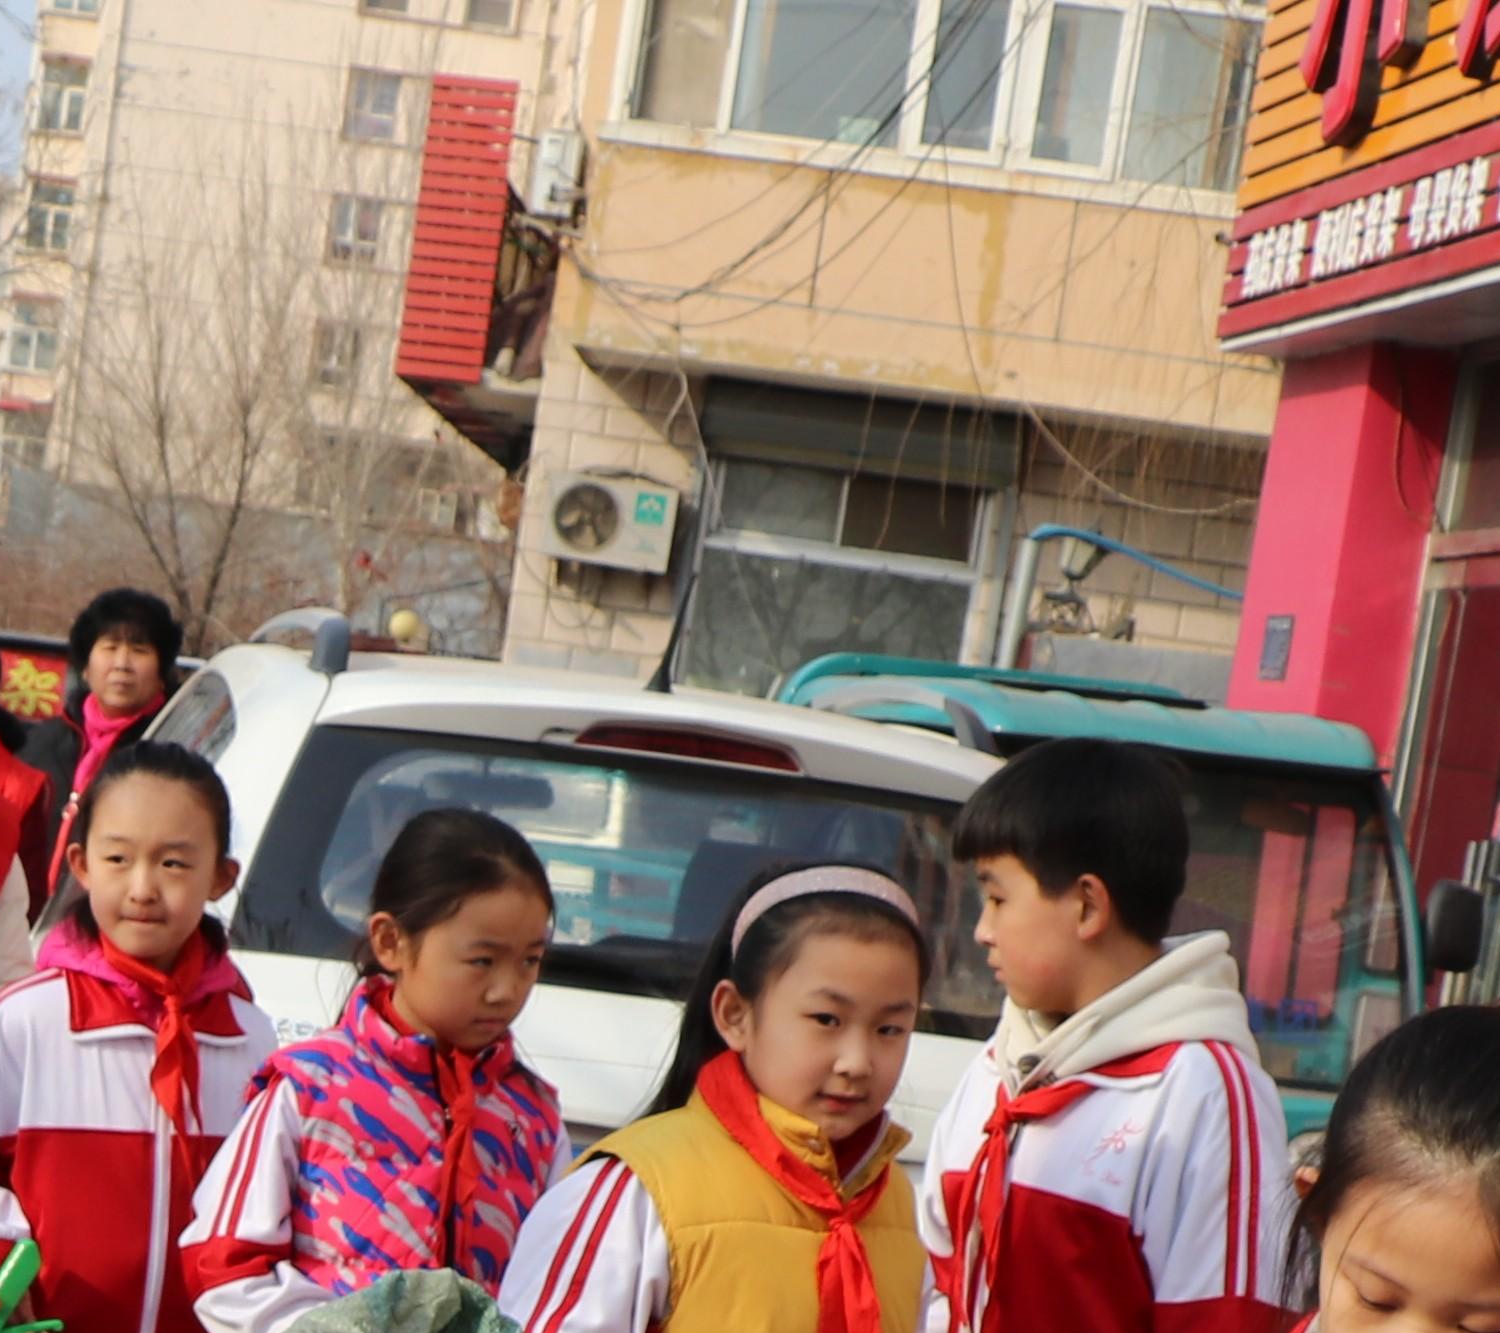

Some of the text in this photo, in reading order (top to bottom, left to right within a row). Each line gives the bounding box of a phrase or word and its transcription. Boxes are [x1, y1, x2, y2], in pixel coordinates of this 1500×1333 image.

[1310, 185, 1399, 279] 便利店货架
[1407, 156, 1491, 249] 母婴货架
